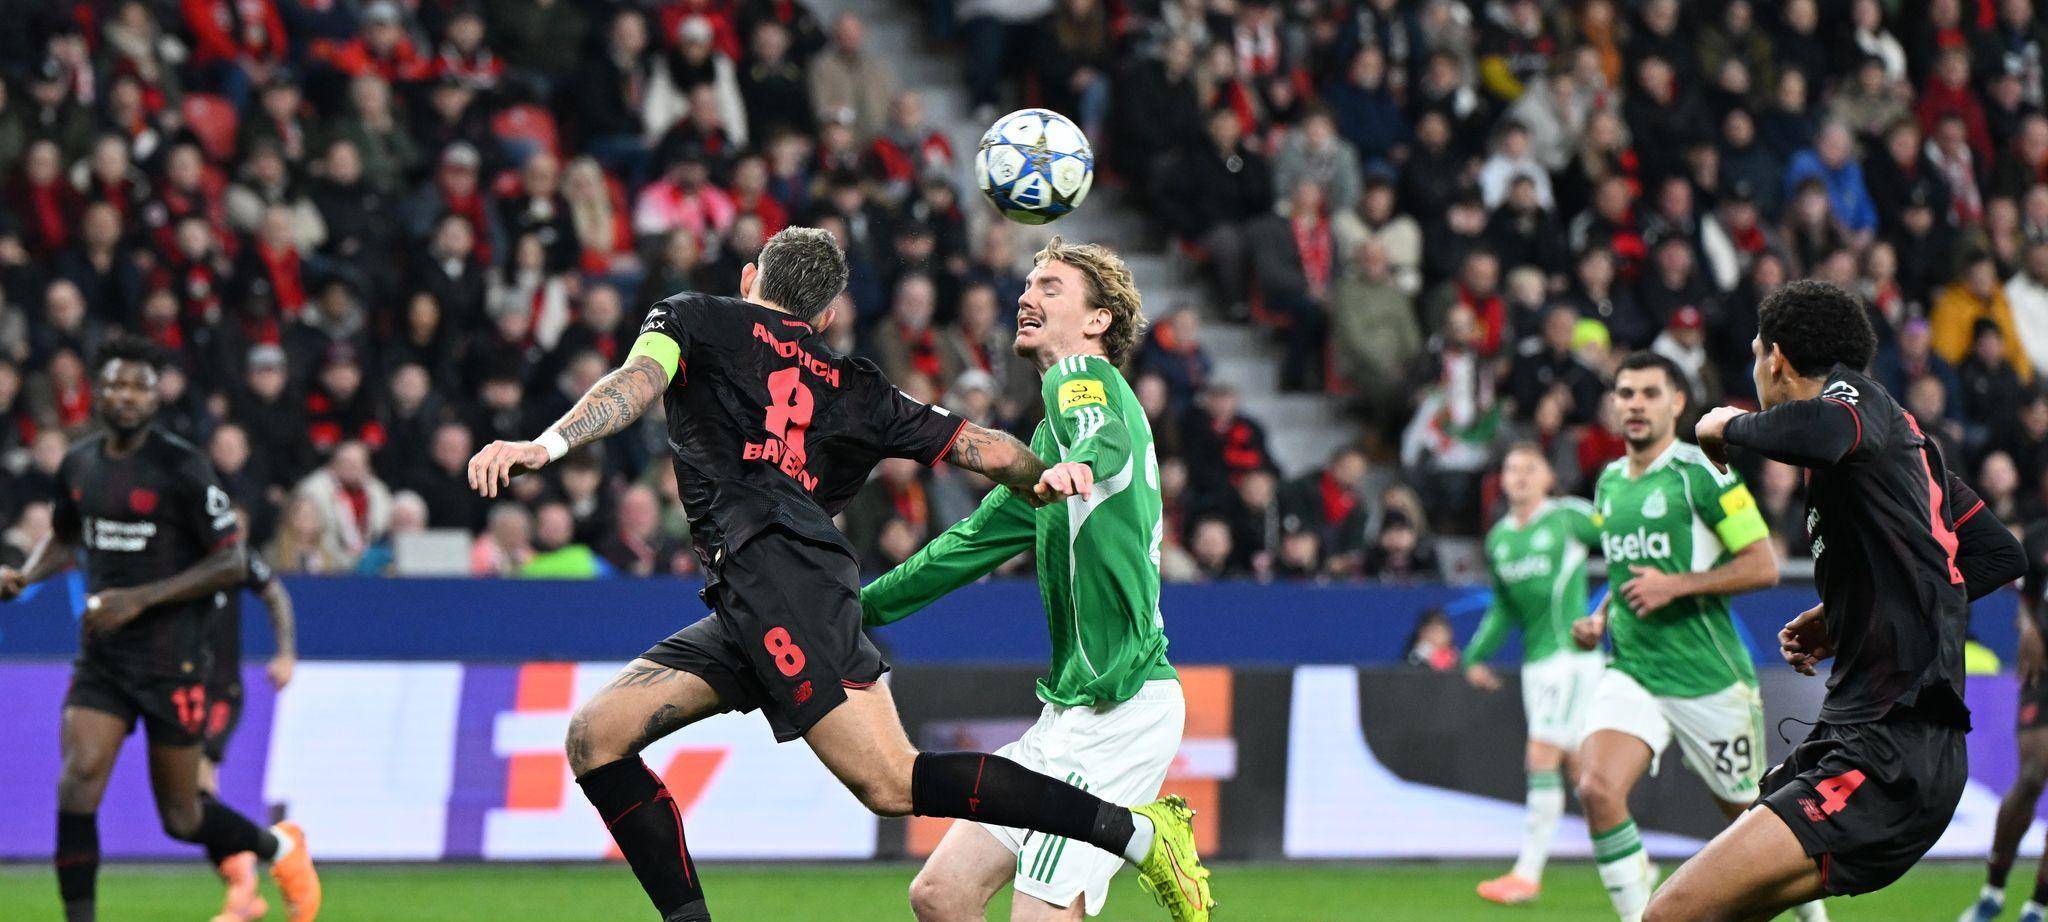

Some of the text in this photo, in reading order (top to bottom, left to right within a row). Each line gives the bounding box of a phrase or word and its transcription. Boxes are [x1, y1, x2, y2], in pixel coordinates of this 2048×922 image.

[752, 322, 839, 388] ANDRICH
[1062, 394, 1103, 408] noon
[743, 438, 819, 495] BAYERN
[764, 627, 806, 677] 8
[1710, 735, 1752, 775] 39
[1815, 769, 1867, 816] 4
